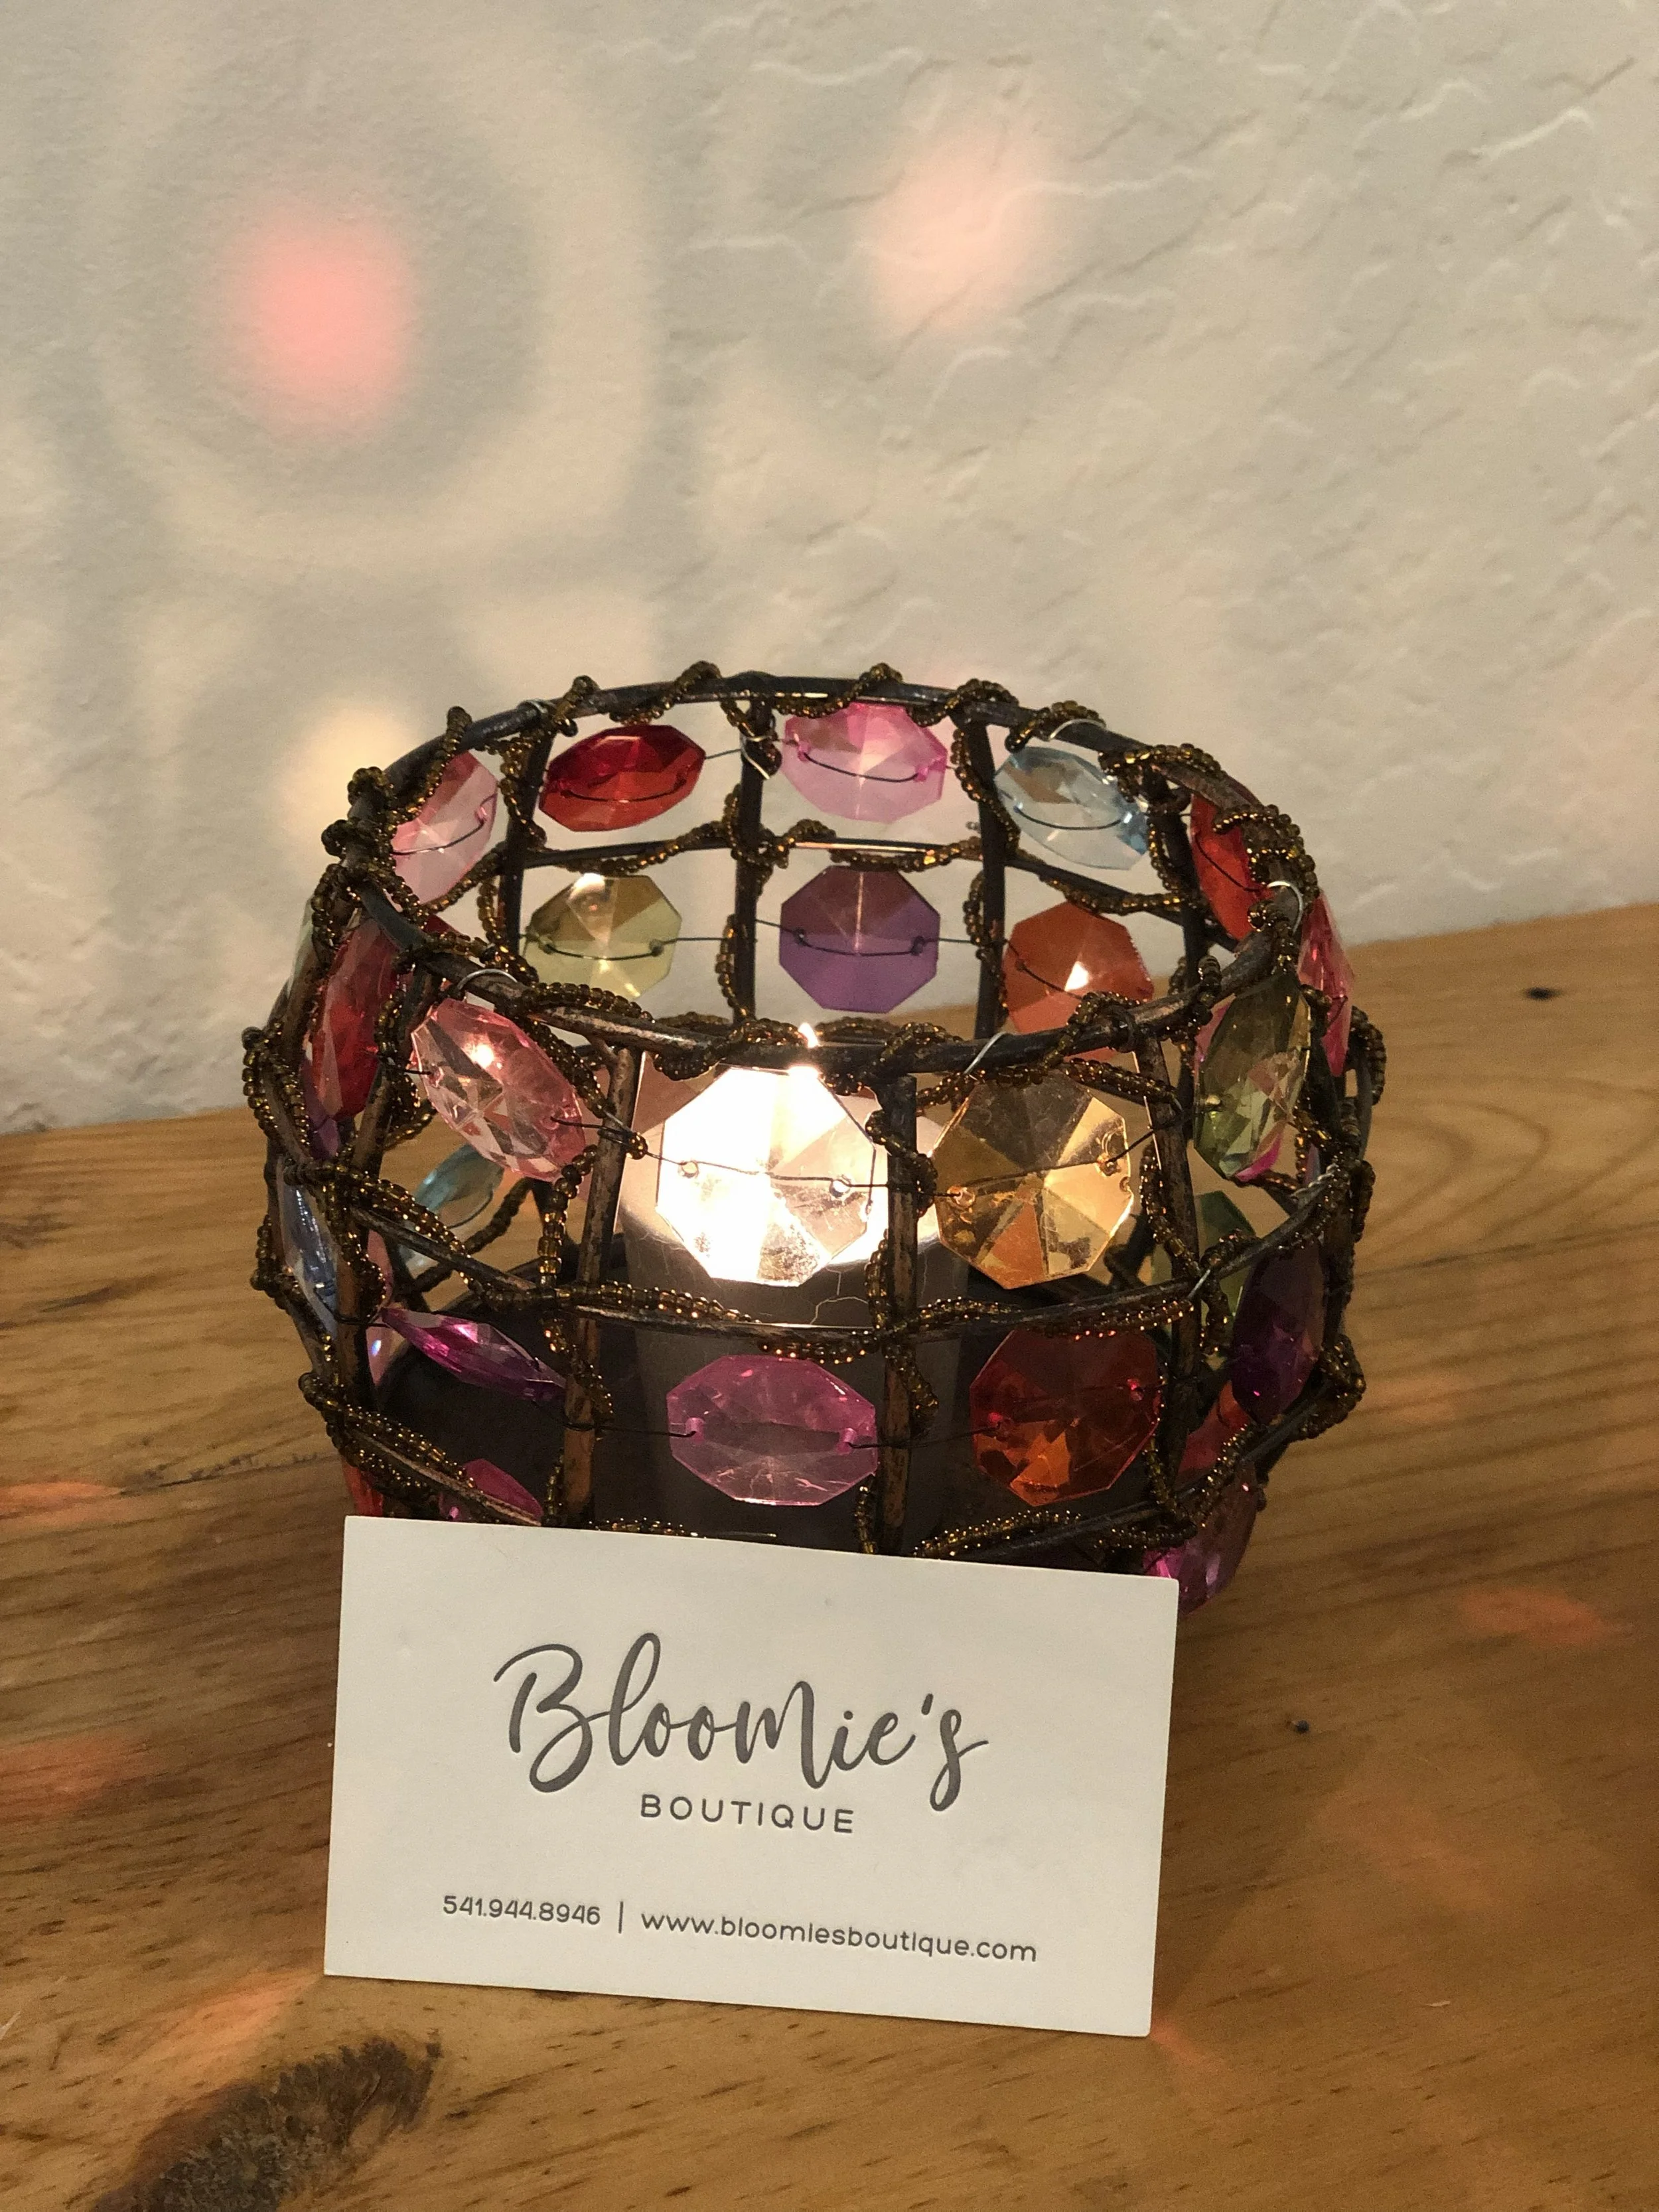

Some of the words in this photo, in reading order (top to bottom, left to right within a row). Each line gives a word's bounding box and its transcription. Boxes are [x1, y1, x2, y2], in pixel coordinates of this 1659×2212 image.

[640, 1793, 855, 1834] BOUTIQUE
[443, 1895, 601, 1925] 541.944.8946
[641, 1913, 1037, 1962] www.bloomiesboutique.com
